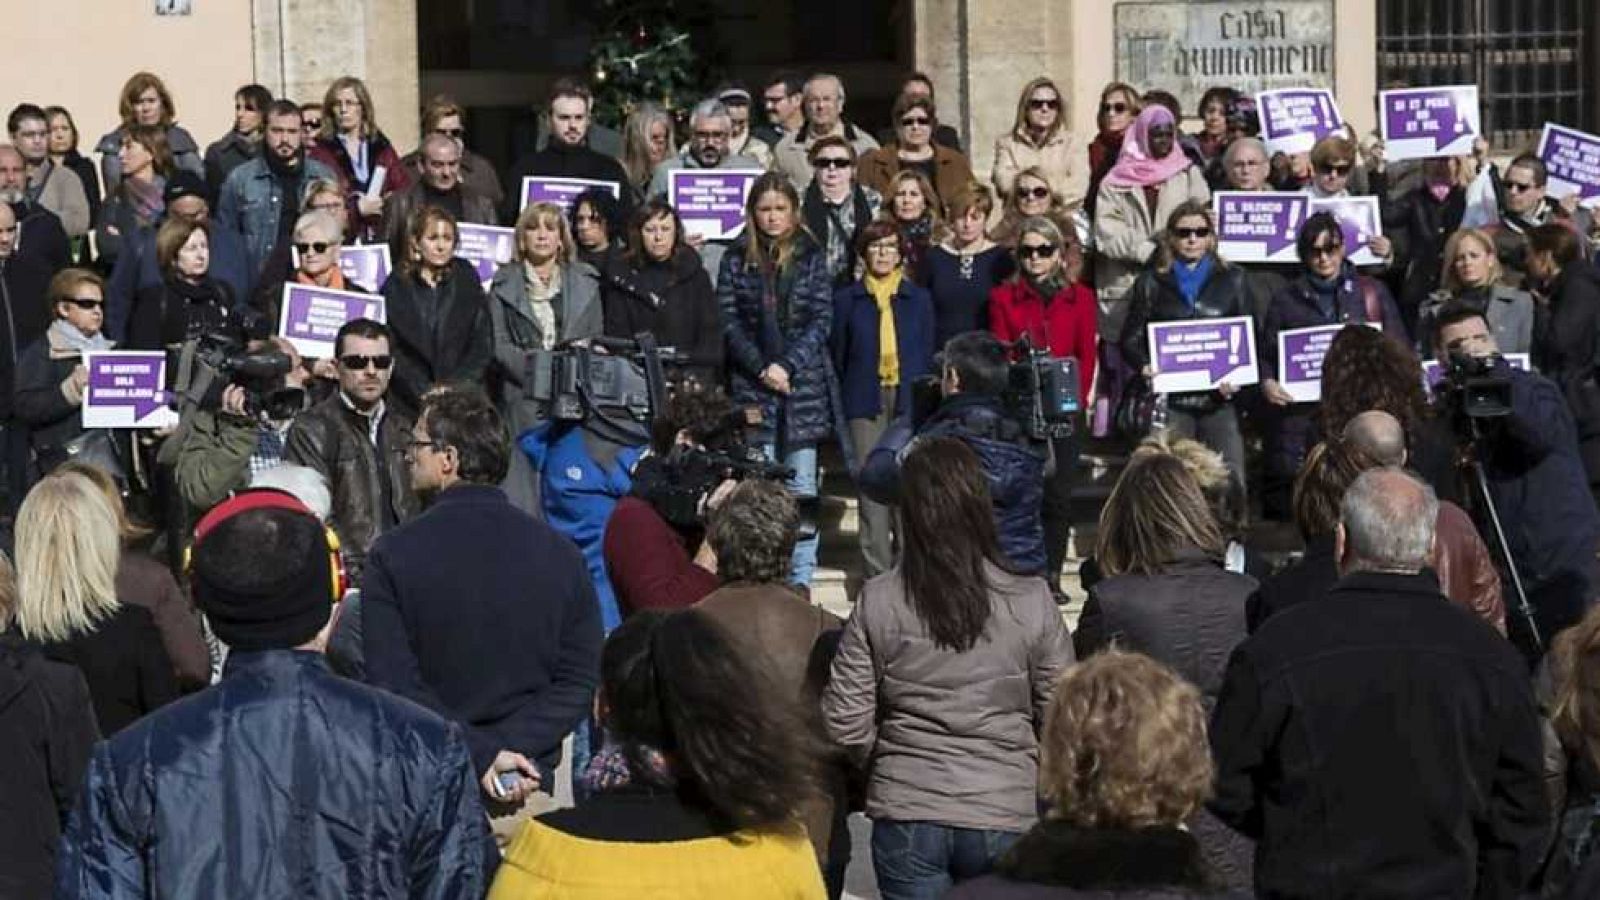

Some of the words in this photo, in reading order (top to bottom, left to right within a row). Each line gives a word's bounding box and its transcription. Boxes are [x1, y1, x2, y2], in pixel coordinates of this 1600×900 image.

[1225, 202, 1236, 212] EL
[1240, 202, 1283, 213] SILENCIO
[1225, 213, 1244, 223] NOS
[1249, 213, 1273, 223] HACE
[1224, 224, 1276, 235] COMPLICES
